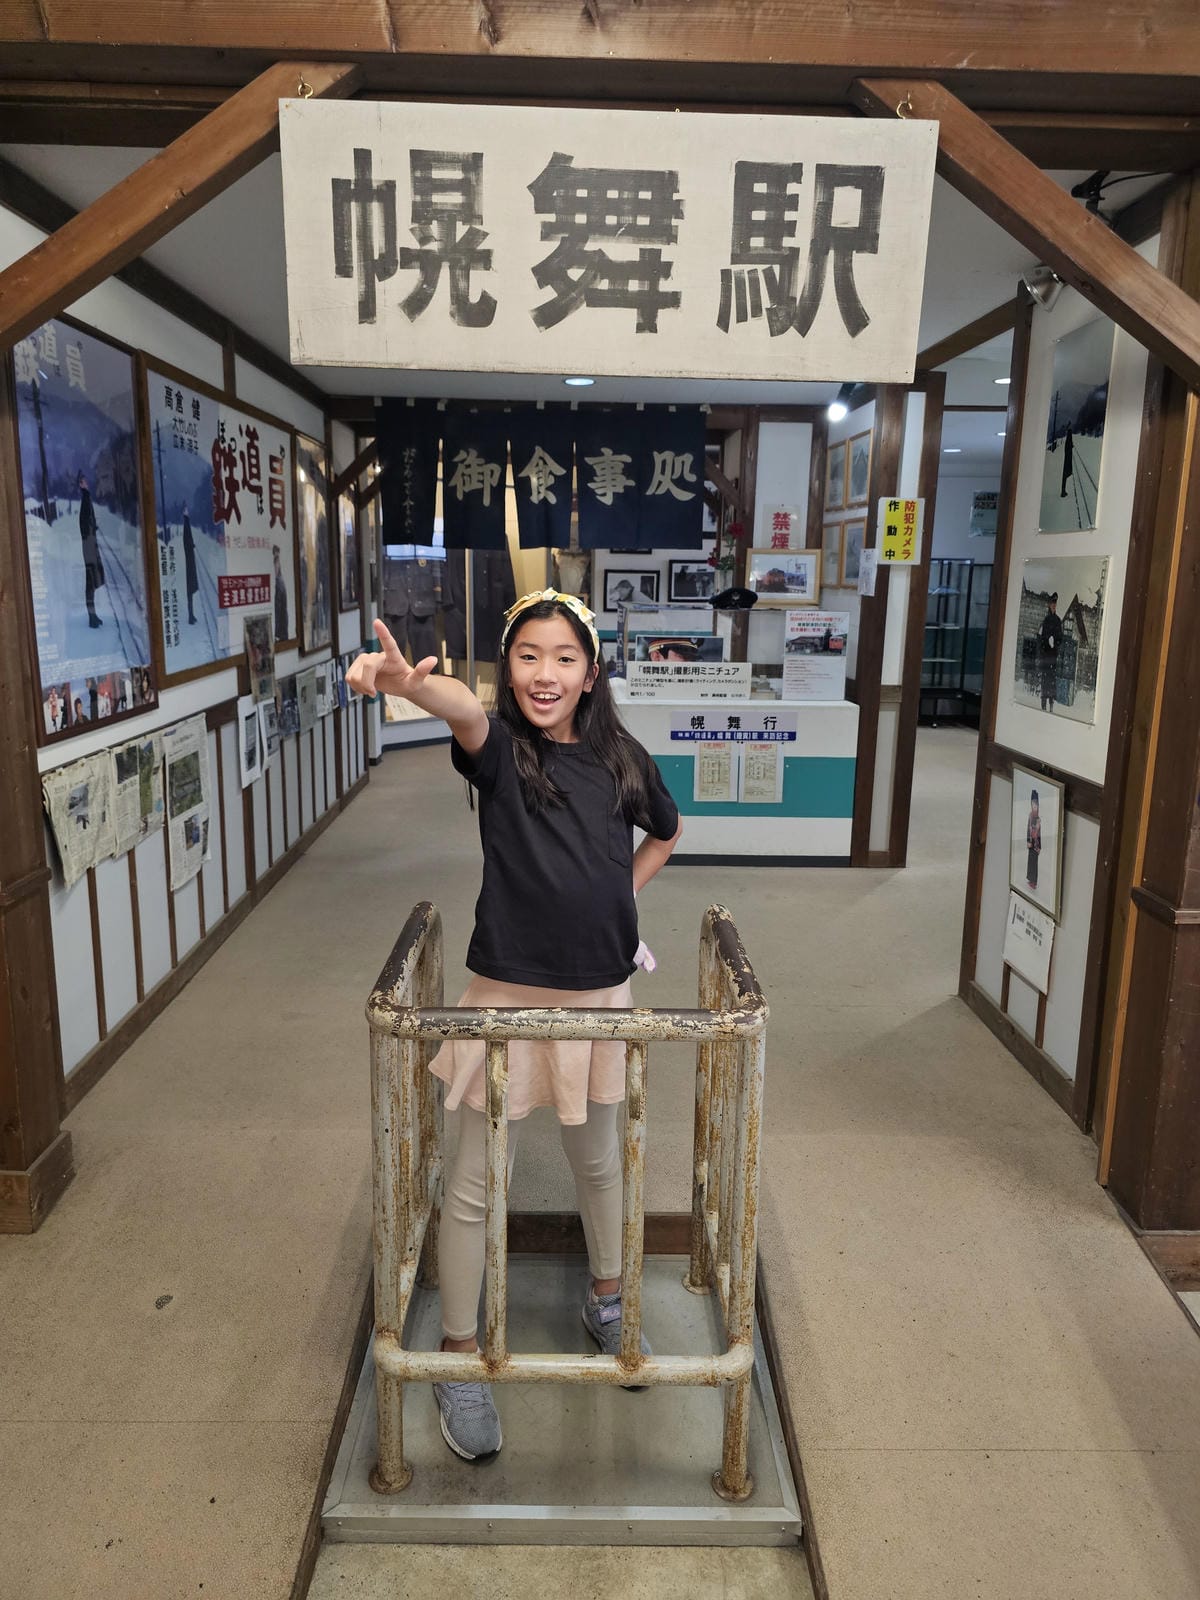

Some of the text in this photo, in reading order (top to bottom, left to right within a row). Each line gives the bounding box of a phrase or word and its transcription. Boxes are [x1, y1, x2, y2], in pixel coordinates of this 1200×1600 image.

[331, 147, 887, 338] 幌舞駅
[211, 423, 287, 530] 鉄道員
[449, 444, 698, 507] 御食事処
[771, 511, 791, 550] 禁煙
[885, 500, 900, 560] 作動中
[901, 500, 916, 560] 防犯カメラ
[690, 715, 778, 730] 幌舞行
